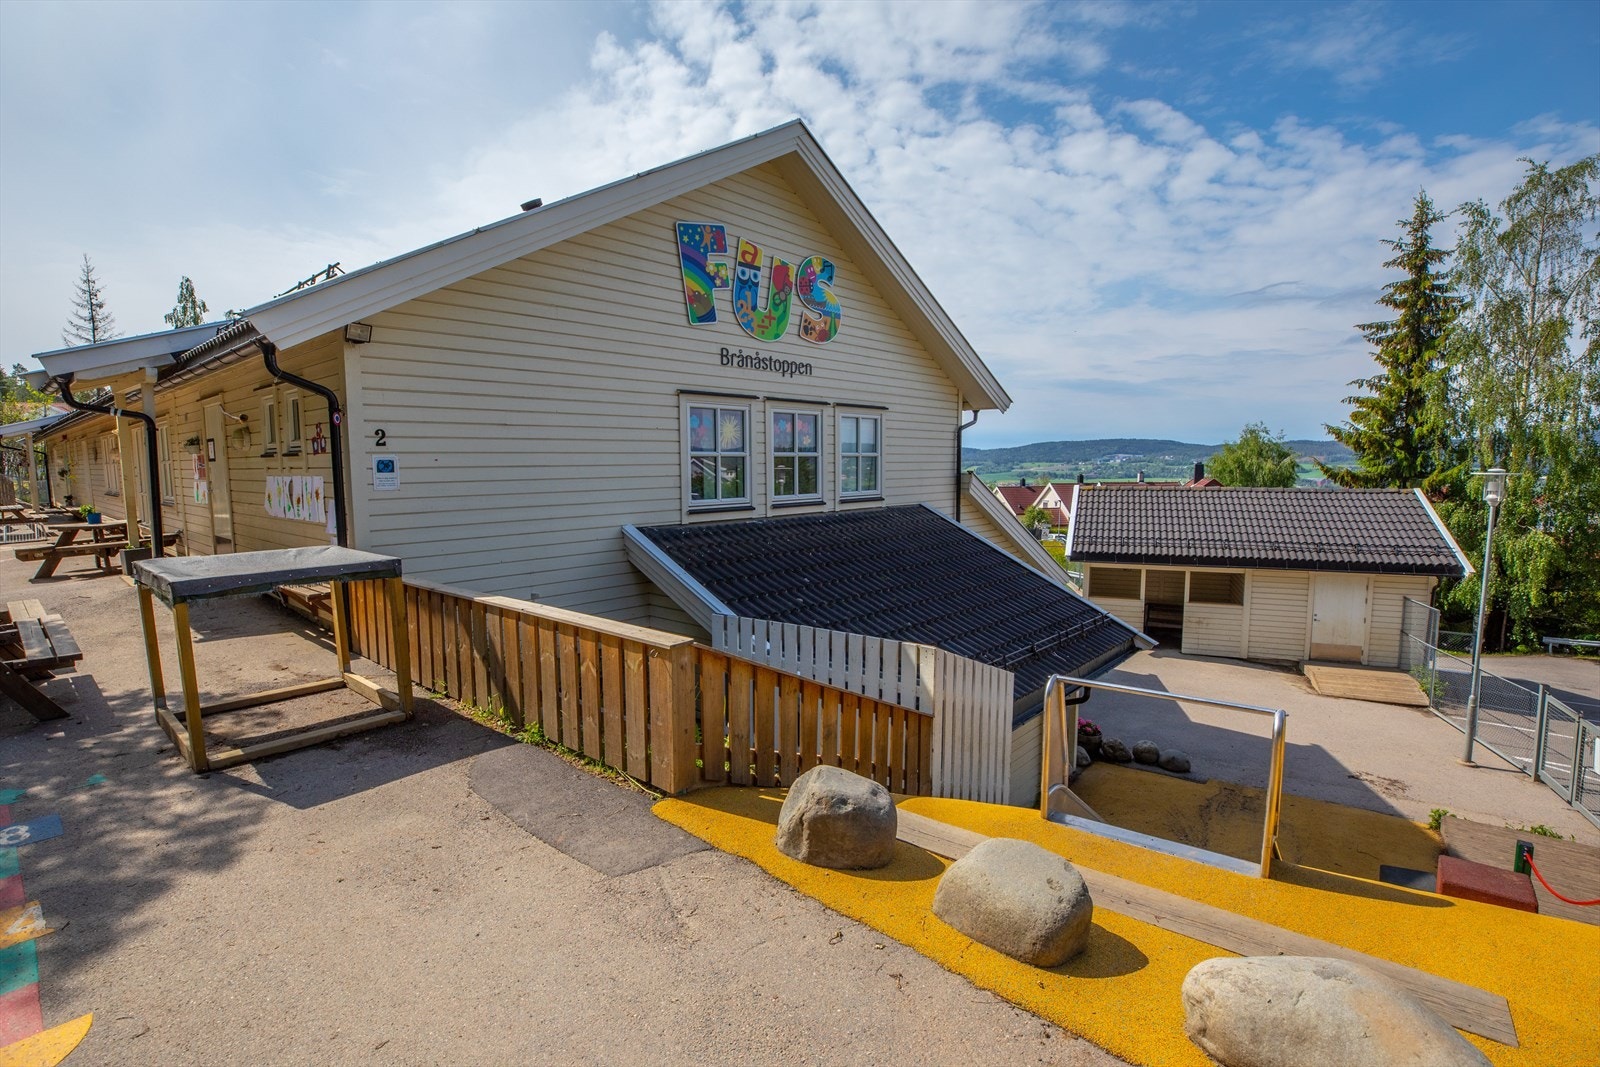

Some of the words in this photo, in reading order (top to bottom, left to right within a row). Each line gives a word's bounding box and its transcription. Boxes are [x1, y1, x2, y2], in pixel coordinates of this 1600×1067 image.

[676, 220, 842, 345] FUS
[720, 347, 812, 378] Brånåstoppen
[374, 428, 386, 446] 2
[0, 825, 31, 845] 8
[5, 904, 46, 934] 4
